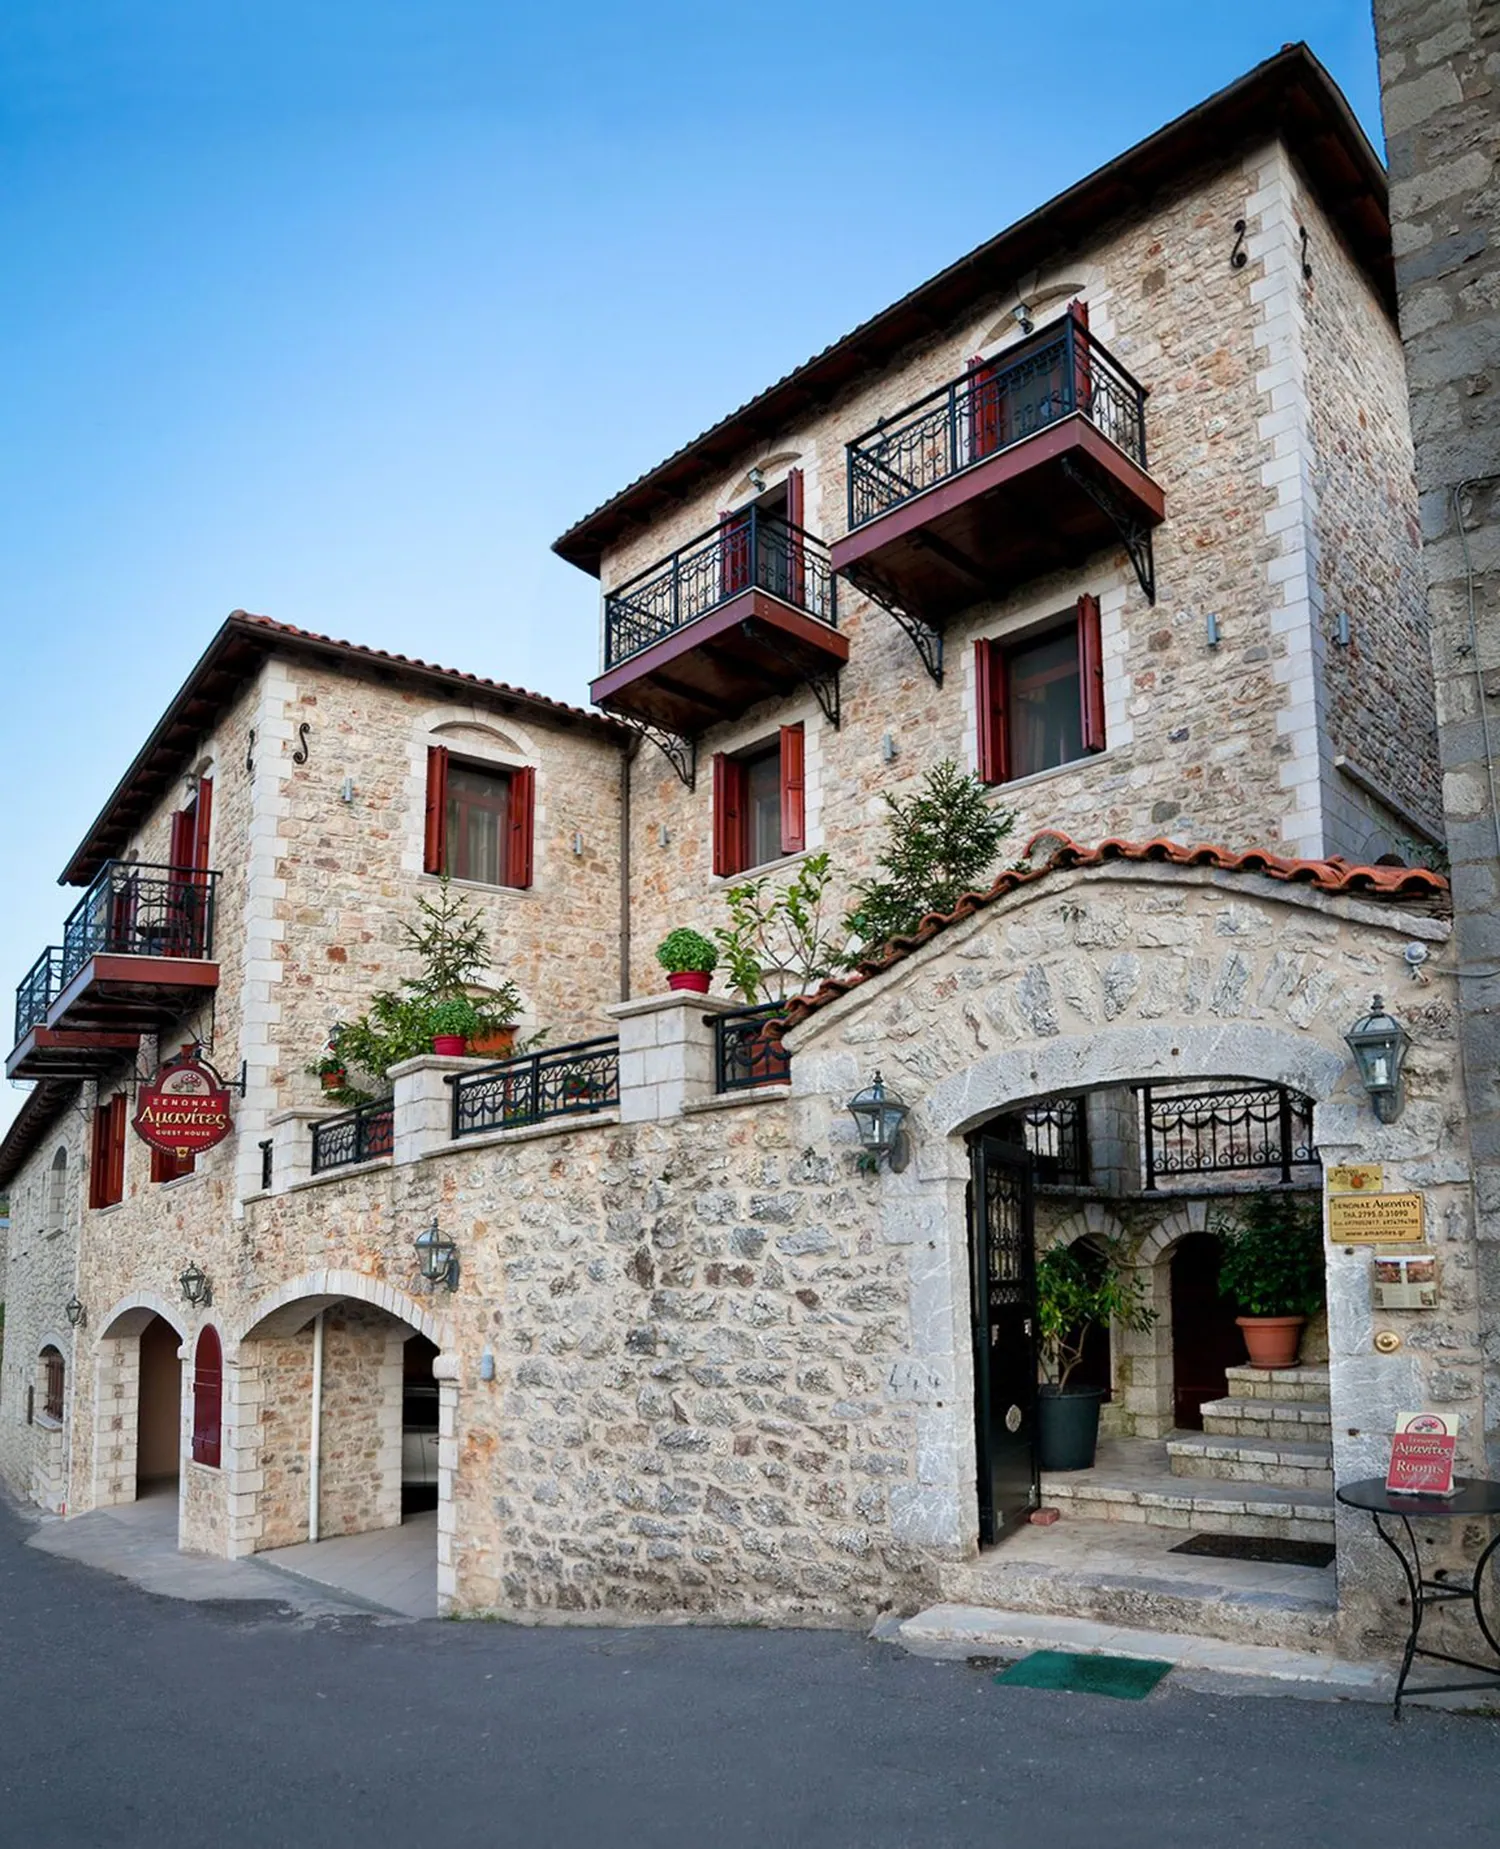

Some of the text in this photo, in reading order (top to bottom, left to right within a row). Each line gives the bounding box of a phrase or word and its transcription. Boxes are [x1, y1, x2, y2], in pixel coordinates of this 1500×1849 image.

[153, 1098, 217, 1107] ΞΕΝΩΝΑΣ
[139, 1106, 227, 1130] Αμανίτες
[1373, 1199, 1418, 1210] Αμανίτες
[1395, 1442, 1451, 1457] Αμανίτες
[1396, 1459, 1444, 1474] Rooms
